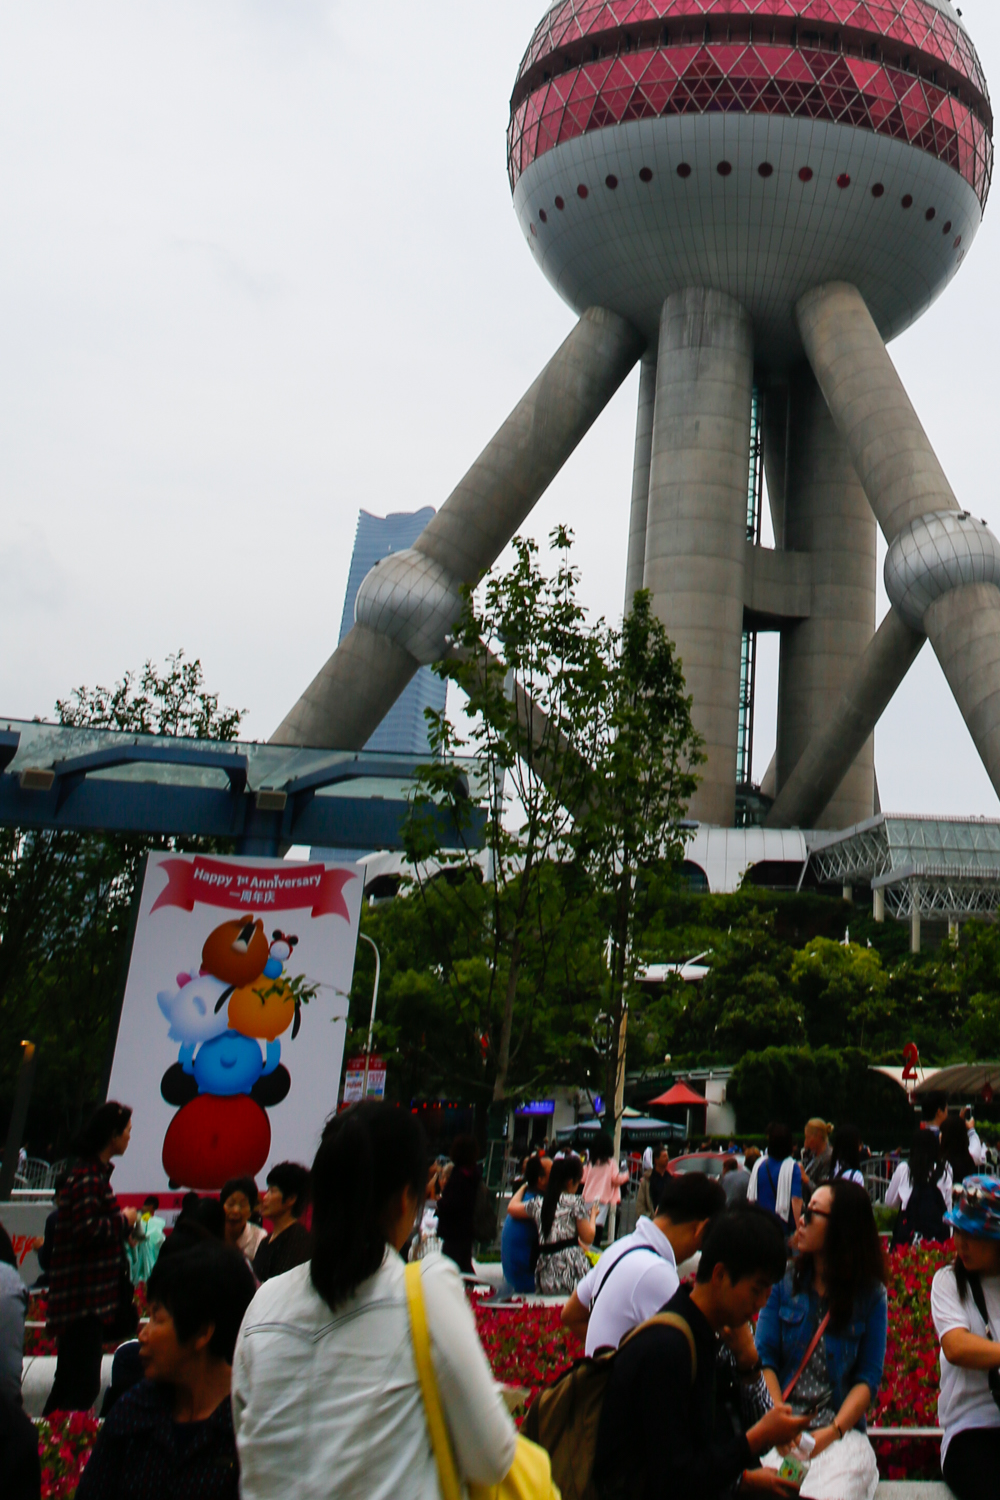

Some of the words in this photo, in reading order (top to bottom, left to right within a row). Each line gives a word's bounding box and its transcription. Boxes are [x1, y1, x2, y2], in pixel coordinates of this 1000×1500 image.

[194, 867, 232, 888] Happy
[237, 875, 250, 887] 1st
[250, 873, 321, 889] Anniversary
[229, 890, 276, 904] 一周年庆
[902, 1042, 918, 1079] 2
